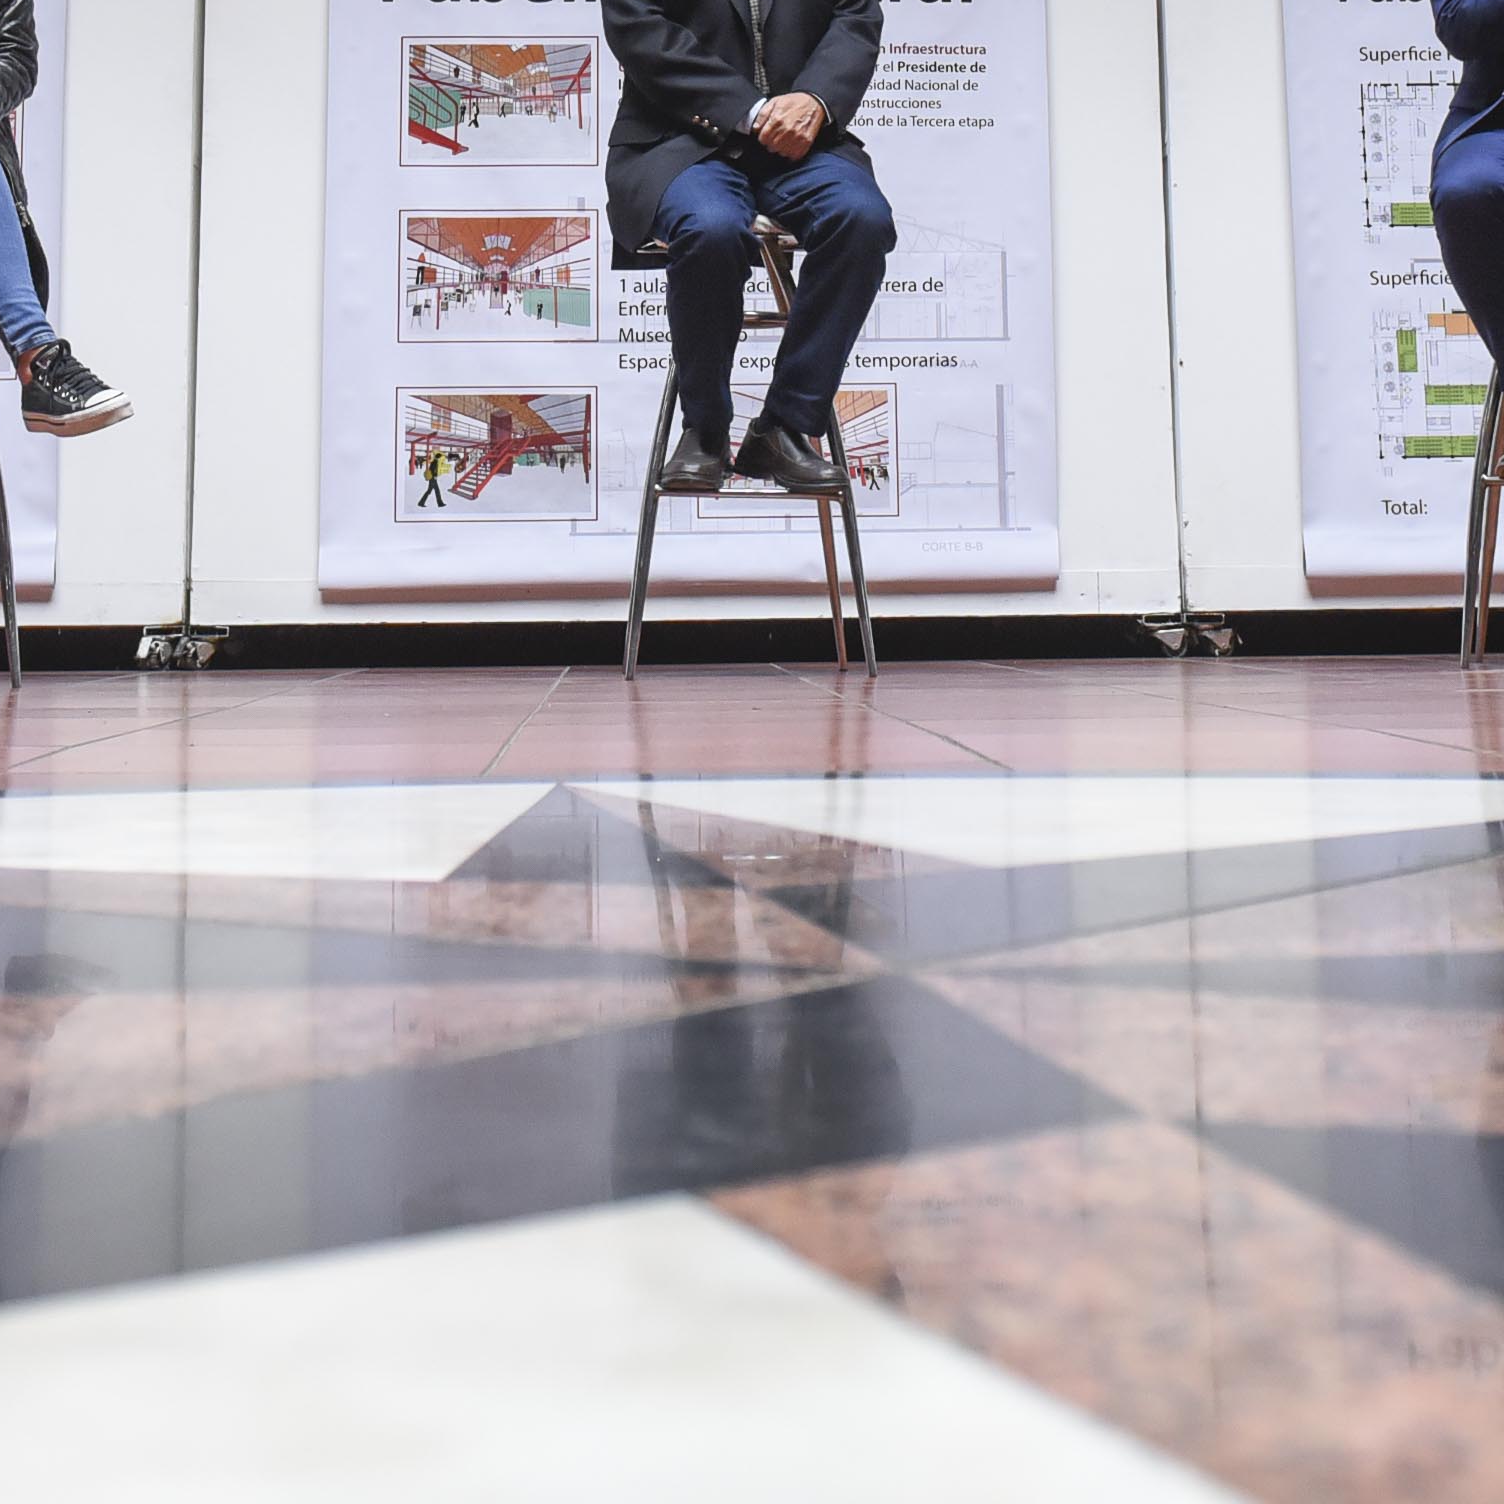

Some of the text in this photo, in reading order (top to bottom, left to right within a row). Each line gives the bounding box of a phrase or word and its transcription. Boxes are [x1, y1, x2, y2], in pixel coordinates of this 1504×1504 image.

[890, 43, 986, 54] Infraestructura
[1360, 46, 1441, 65] Superficie
[883, 61, 893, 72] el
[898, 61, 966, 72] Presidente
[970, 62, 986, 72] de
[905, 80, 958, 90] Nacional
[963, 80, 978, 91] de
[862, 99, 941, 109] nstrucciones
[878, 115, 893, 126] de
[897, 115, 907, 126] la
[910, 116, 954, 127] Tercera
[959, 117, 994, 129] etapa
[620, 279, 625, 292] 1
[881, 277, 943, 293] rrera de
[1370, 271, 1453, 288] Superficie
[619, 301, 665, 316] Enfer
[619, 354, 671, 371] Espaci
[855, 353, 957, 371] temporarias
[1381, 500, 1428, 515] Total:
